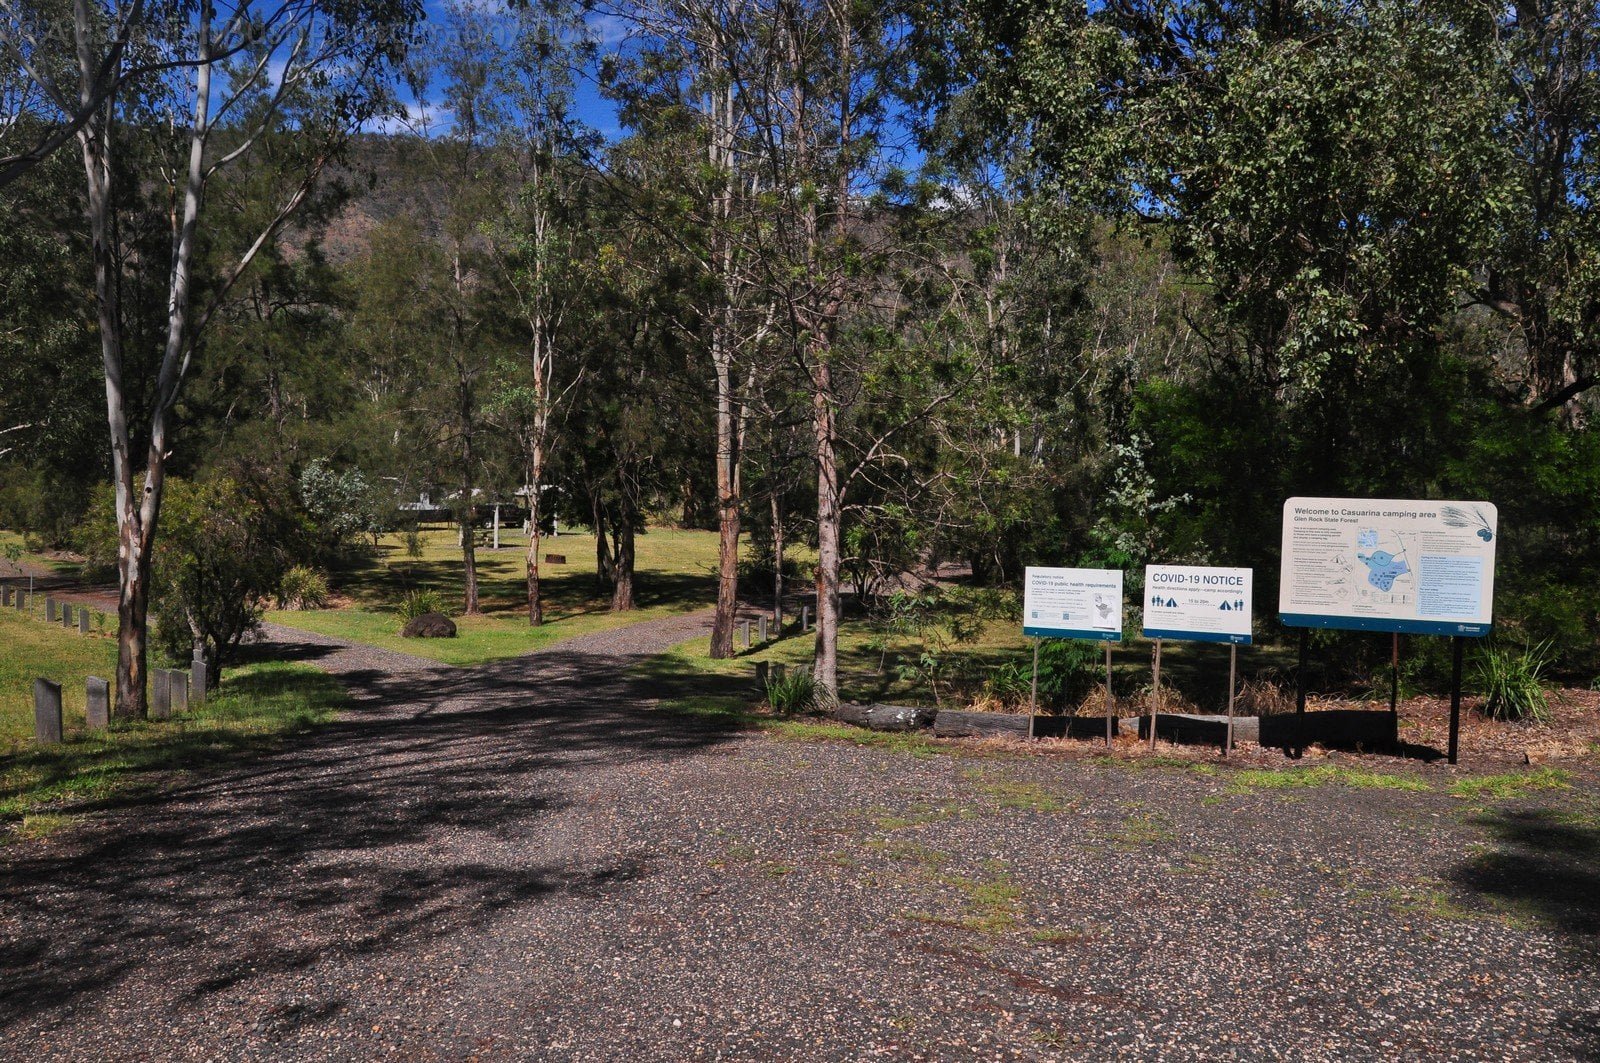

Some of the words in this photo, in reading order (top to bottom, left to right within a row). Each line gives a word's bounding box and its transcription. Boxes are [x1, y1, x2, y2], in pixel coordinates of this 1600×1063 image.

[1341, 509, 1381, 517] Casuarina
[1382, 510, 1417, 519] camping
[1152, 573, 1200, 584] COVID-19
[1202, 575, 1244, 586] NOTICE
